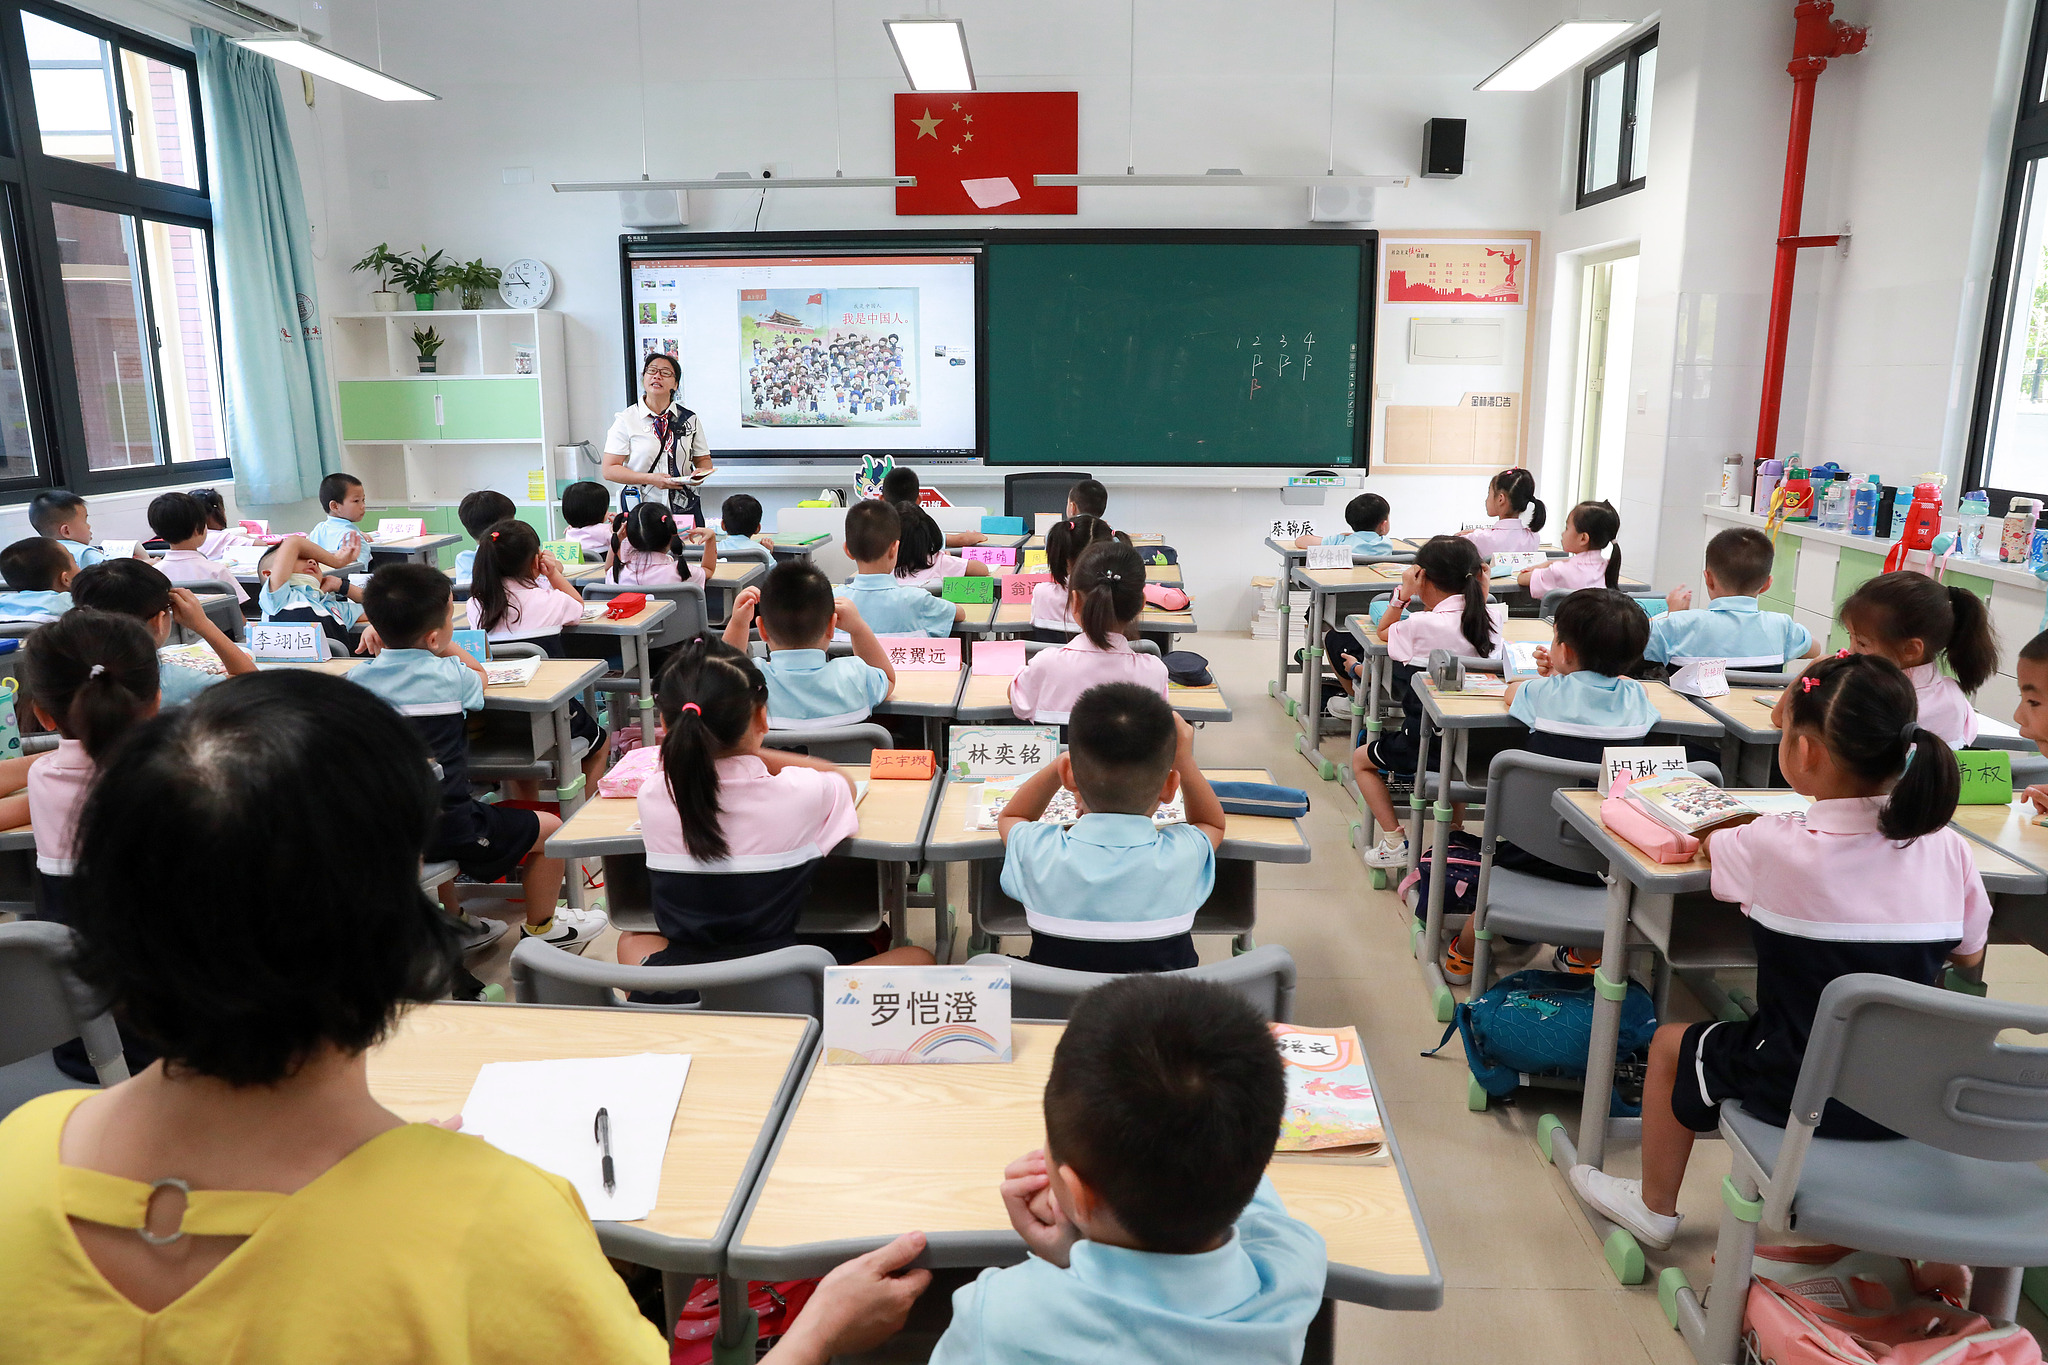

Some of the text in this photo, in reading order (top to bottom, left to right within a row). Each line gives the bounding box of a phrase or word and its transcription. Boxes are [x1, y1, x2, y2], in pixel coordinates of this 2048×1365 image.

[842, 312, 909, 324] 我是中国人。
[1237, 332, 1316, 352] 1 2 3 4
[1272, 520, 1314, 538] 蔡锦辰
[254, 630, 313, 650] 李翊恒
[890, 647, 946, 664] 蔡翼远
[968, 743, 1042, 765] 林奕铭
[871, 991, 977, 1026] 罗恺澄
[1280, 1039, 1336, 1055] 语文
